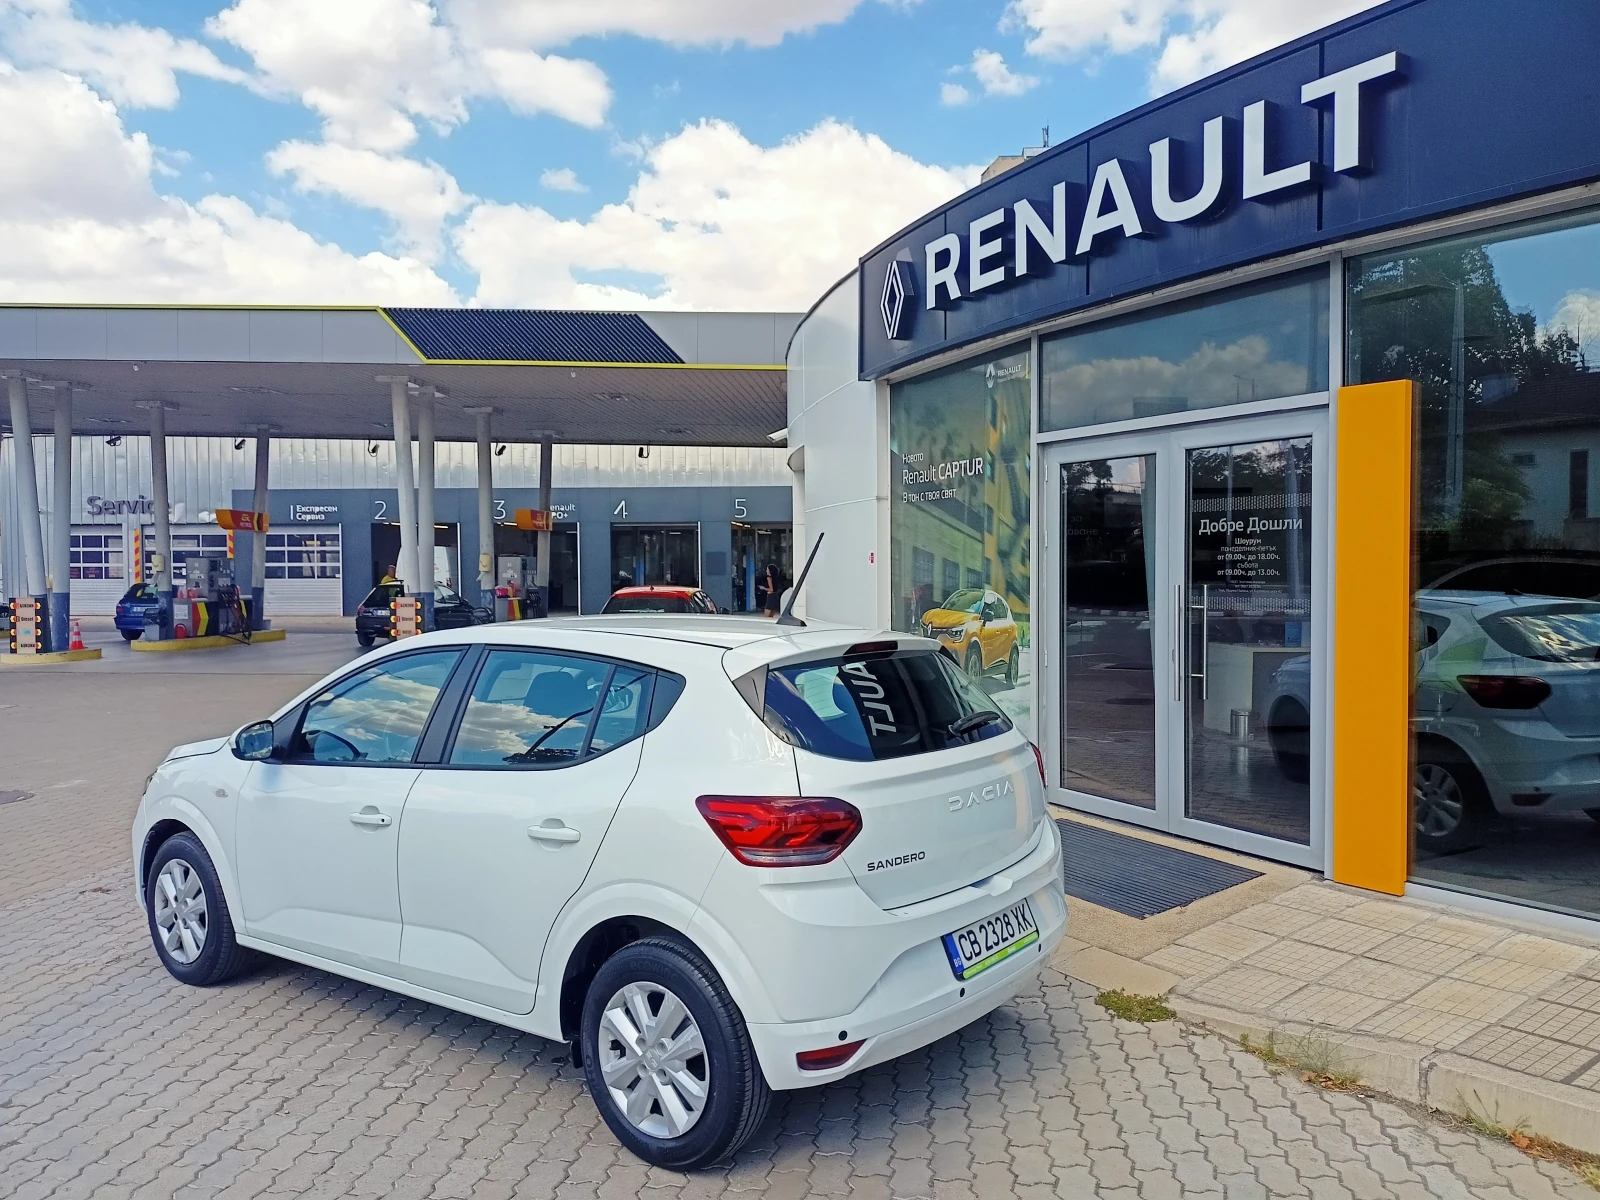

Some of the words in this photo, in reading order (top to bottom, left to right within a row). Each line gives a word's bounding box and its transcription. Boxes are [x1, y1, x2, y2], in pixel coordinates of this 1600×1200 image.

[925, 51, 1397, 310] RENAULT
[997, 364, 1022, 377] RENAULT
[902, 452, 924, 464] Новото
[902, 465, 937, 485] Renault
[938, 457, 984, 480] CAPTUR
[902, 491, 908, 503] В
[908, 493, 920, 502] тон
[925, 492, 940, 501] твоя
[941, 488, 957, 499] свят
[86, 495, 171, 515] Servic
[296, 504, 338, 514] Експресен
[374, 500, 387, 520] 2
[493, 500, 506, 520] 3
[550, 503, 576, 511] enault
[613, 499, 628, 519] 4
[734, 498, 747, 519] 5
[296, 512, 325, 522] Сервиз
[1067, 528, 1099, 536] аване
[1198, 518, 1244, 535] Добре
[1247, 517, 1303, 534] Дошли
[1234, 537, 1262, 545] Шоурум
[1236, 561, 1259, 569] събота
[1247, 554, 1256, 562] до
[1247, 569, 1256, 577] до
[1258, 568, 1281, 576] 13.00ч.
[948, 780, 1014, 812] DACIA
[867, 851, 926, 871] SANDERO
[958, 929, 982, 961] CB
[979, 912, 1015, 952] 2328
[1010, 903, 1033, 934] XK
[953, 957, 961, 968] BG
